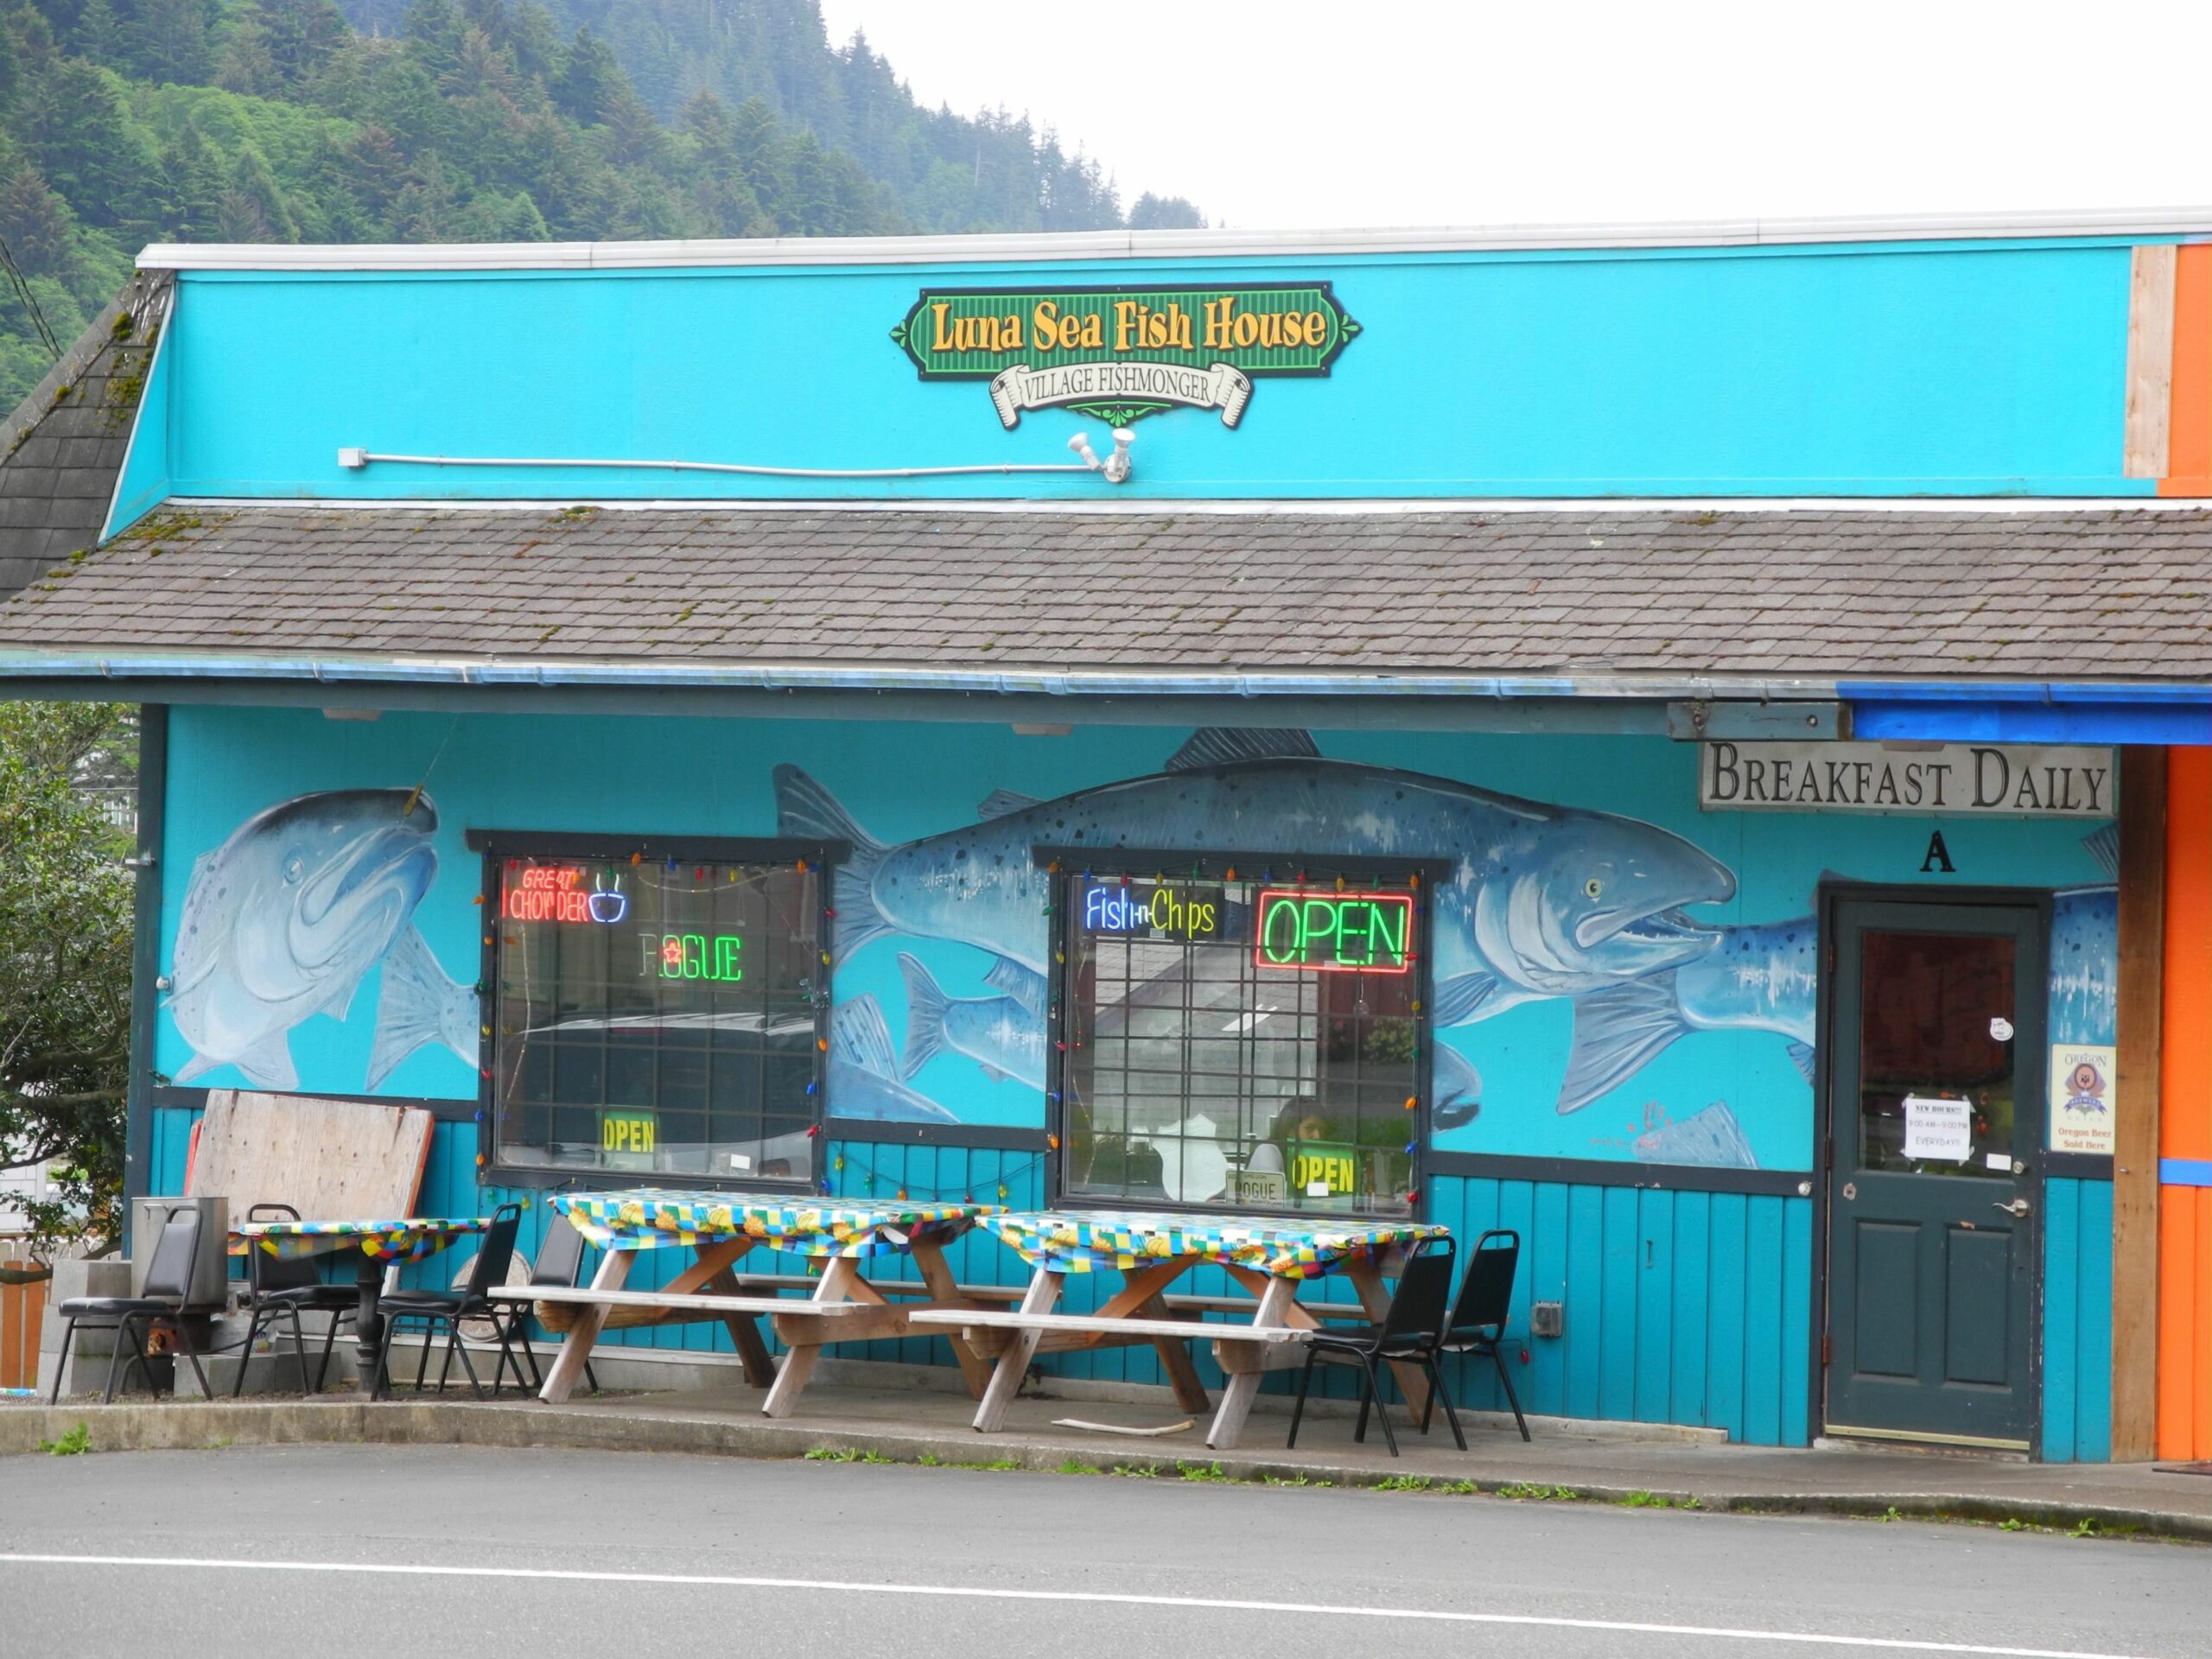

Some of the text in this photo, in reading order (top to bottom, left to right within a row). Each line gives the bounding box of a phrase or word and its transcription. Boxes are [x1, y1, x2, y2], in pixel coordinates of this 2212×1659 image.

[931, 296, 1327, 353] Luna Sea Fish House
[1025, 366, 1211, 403] VILLAGE FISHMONGER
[1709, 742, 2107, 810] BREAKFAST DAILY
[1920, 830, 1955, 873] A
[522, 869, 574, 889] GREAT
[510, 889, 588, 923] CHOWDER
[1264, 899, 1404, 966] OPEN
[638, 933, 742, 982] ROGUE
[2065, 1053, 2107, 1066] OREGON
[603, 1118, 655, 1153] OPEN
[2058, 1128, 2112, 1138] Oregon Beer
[2063, 1140, 2106, 1150] Sold Here
[1293, 1154, 1354, 1192] OPEN
